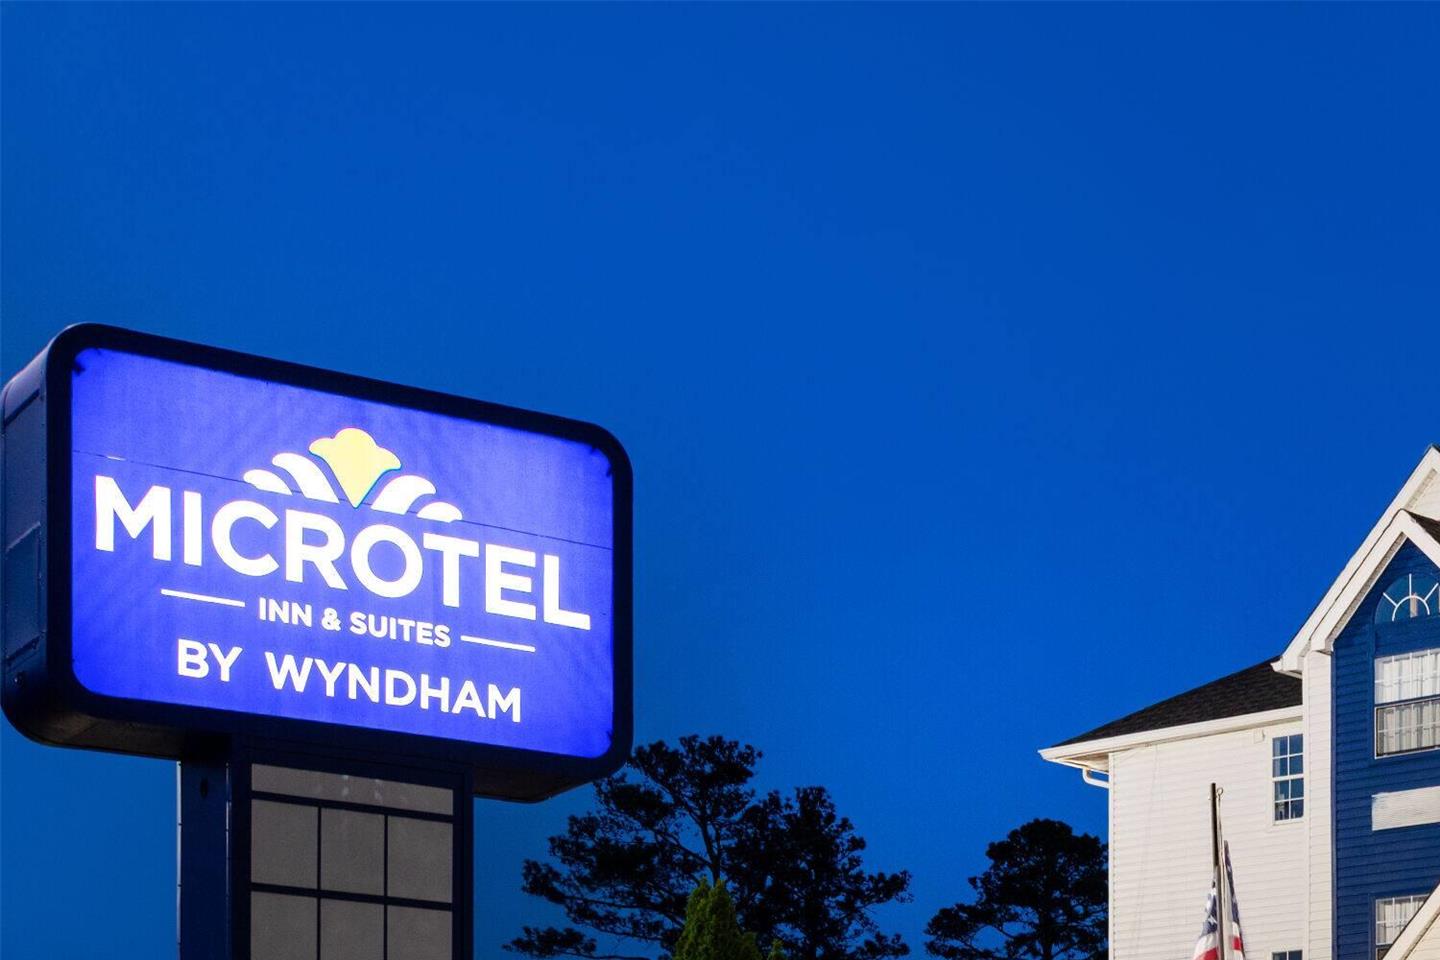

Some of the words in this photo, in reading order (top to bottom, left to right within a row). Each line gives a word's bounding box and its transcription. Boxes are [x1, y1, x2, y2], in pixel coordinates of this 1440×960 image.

[96, 475, 591, 631] MICROTEL
[258, 597, 313, 629] INN
[321, 607, 342, 632] &
[350, 611, 451, 648] SUITES
[177, 638, 243, 682] BY
[265, 652, 522, 723] WYNDHAM
